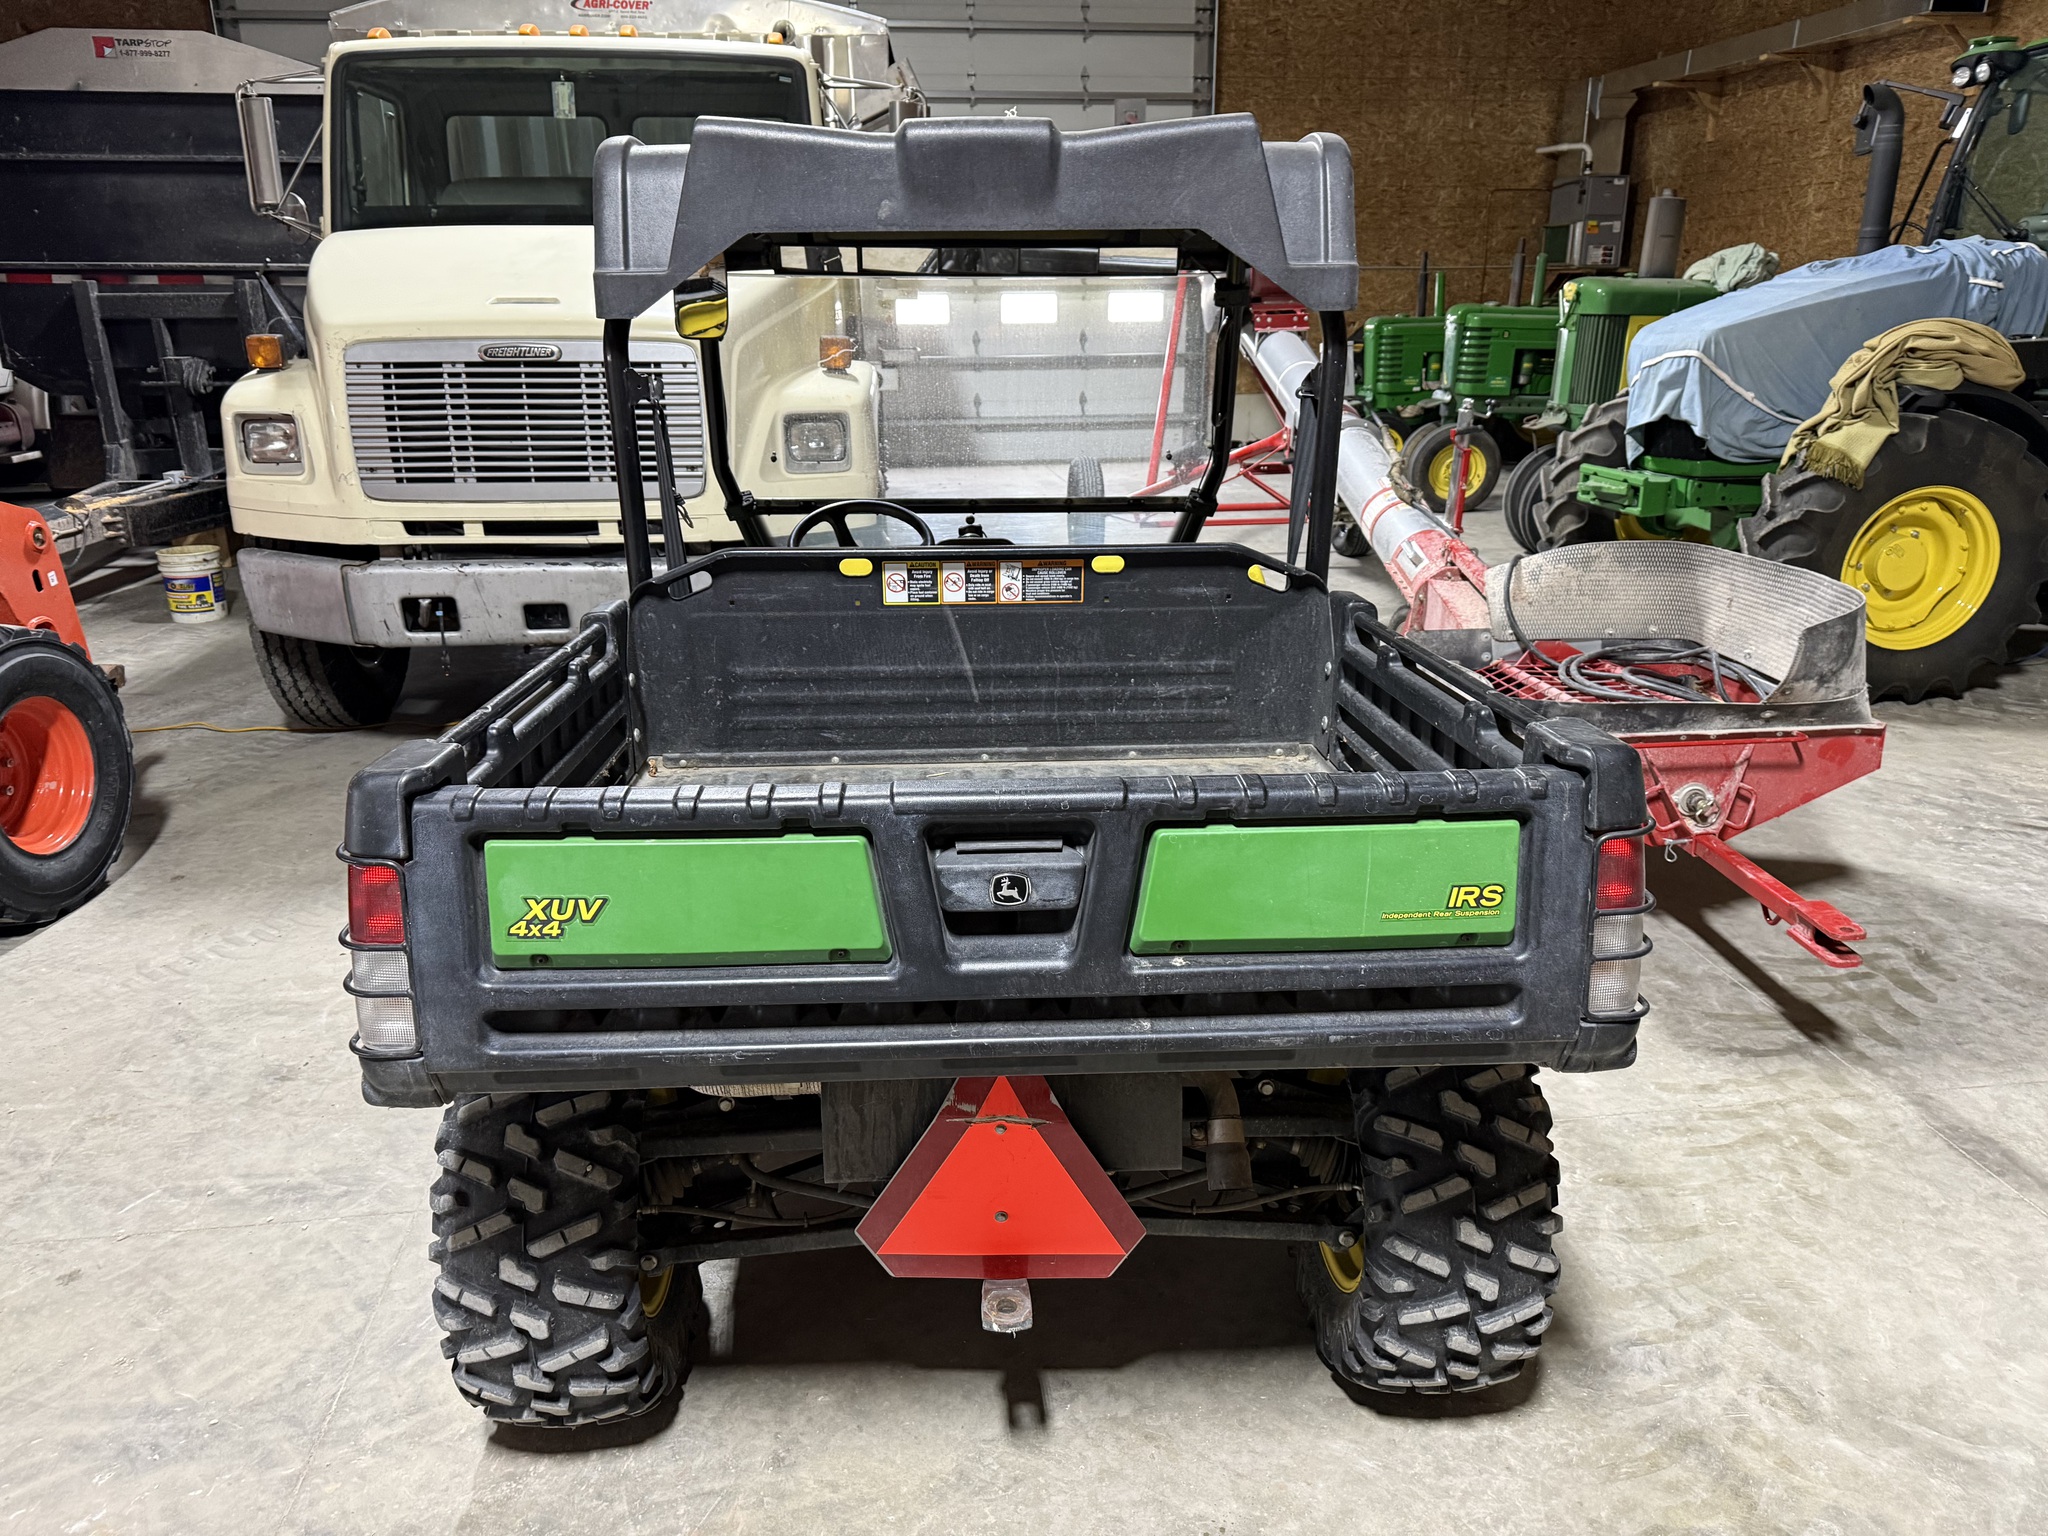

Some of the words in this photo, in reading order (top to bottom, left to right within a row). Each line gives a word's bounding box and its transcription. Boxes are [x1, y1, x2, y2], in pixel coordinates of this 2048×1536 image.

[487, 347, 552, 357] FREIGHTLINER
[1446, 884, 1505, 908] IRS
[522, 898, 606, 923] XUV
[1382, 911, 1431, 920] Independent
[1454, 909, 1500, 917] Suspension
[508, 920, 563, 937] 4x4
